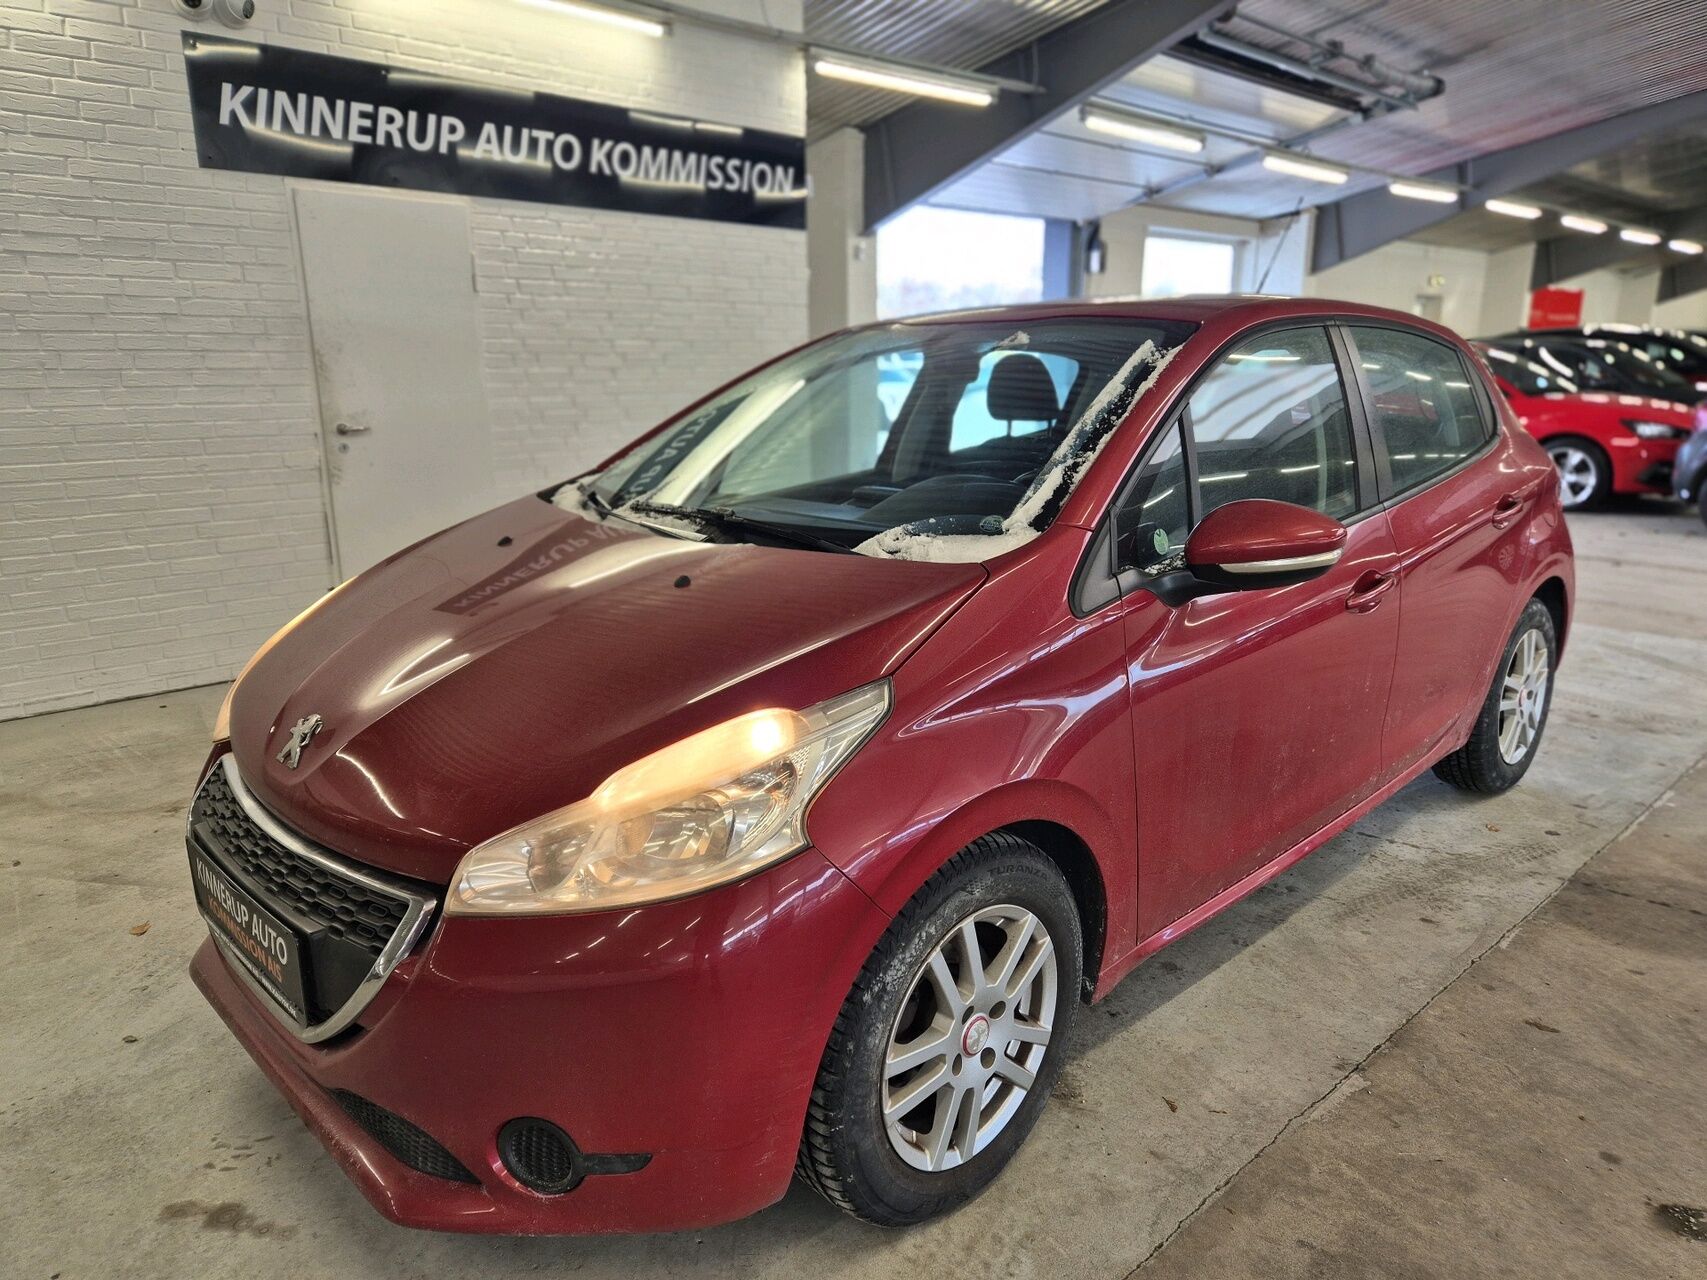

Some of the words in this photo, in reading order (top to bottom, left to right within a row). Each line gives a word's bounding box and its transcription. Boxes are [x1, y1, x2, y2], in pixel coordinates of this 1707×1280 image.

[219, 82, 465, 154] KINNERUP
[473, 122, 582, 171] AUTO
[589, 138, 794, 197] KOMMISSION
[196, 857, 249, 929] KINNERUP
[252, 913, 287, 966] AUTO
[987, 864, 1048, 881] TURANZA
